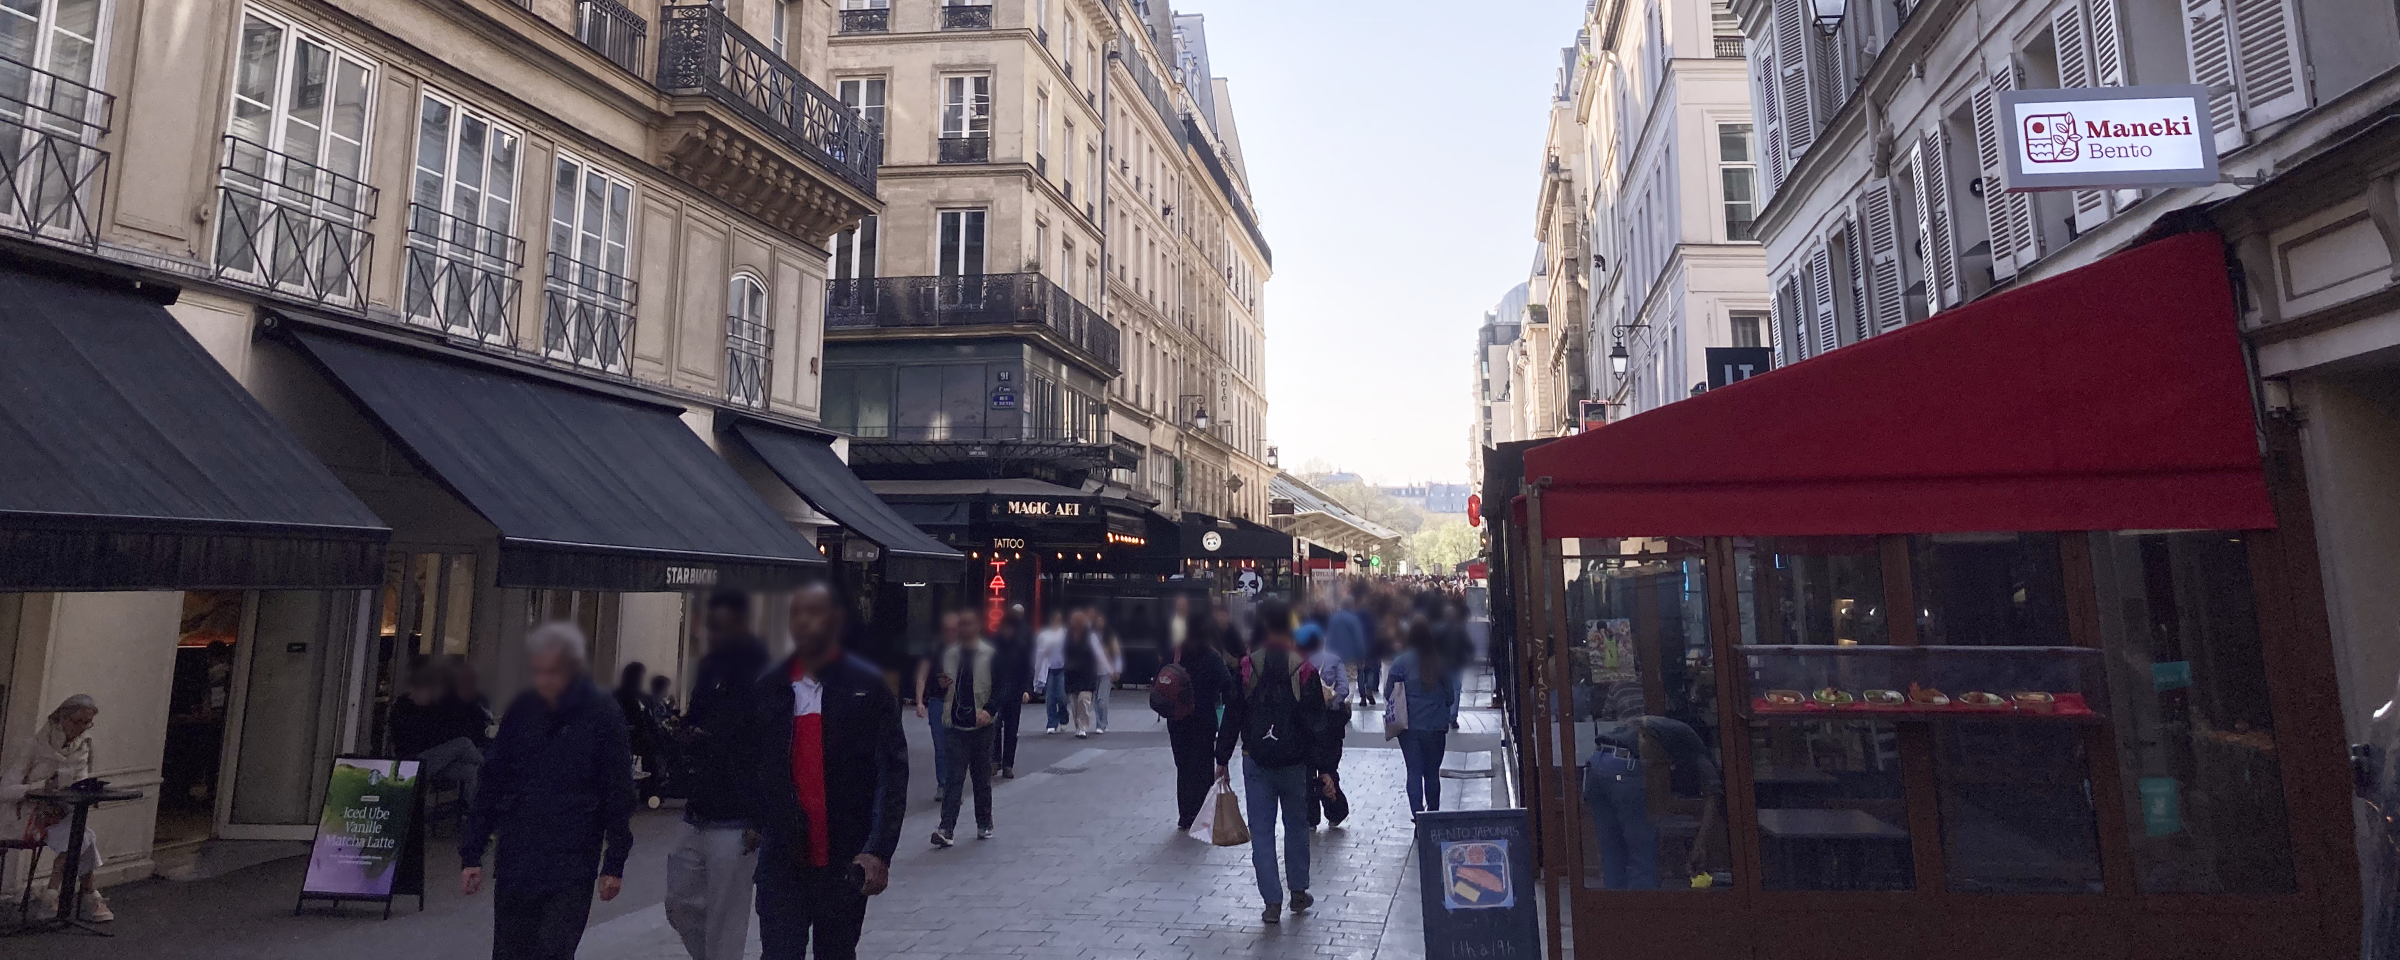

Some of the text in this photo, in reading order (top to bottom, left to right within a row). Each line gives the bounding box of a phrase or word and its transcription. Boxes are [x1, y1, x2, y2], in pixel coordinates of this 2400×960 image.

[2085, 116, 2193, 139] Maneki
[2088, 143, 2153, 159] Bento
[1000, 371, 1009, 380] 91
[1008, 501, 1081, 516] MAGIC ART
[994, 538, 1025, 549] TATTOO
[666, 566, 718, 585] STARBUCKS
[343, 806, 391, 820] Iced Ube
[346, 821, 382, 834] Vanille
[1430, 825, 1520, 843] BENTO JAPONAIS
[324, 834, 395, 849] Matcha Latte
[1491, 939, 1516, 958] 19h
